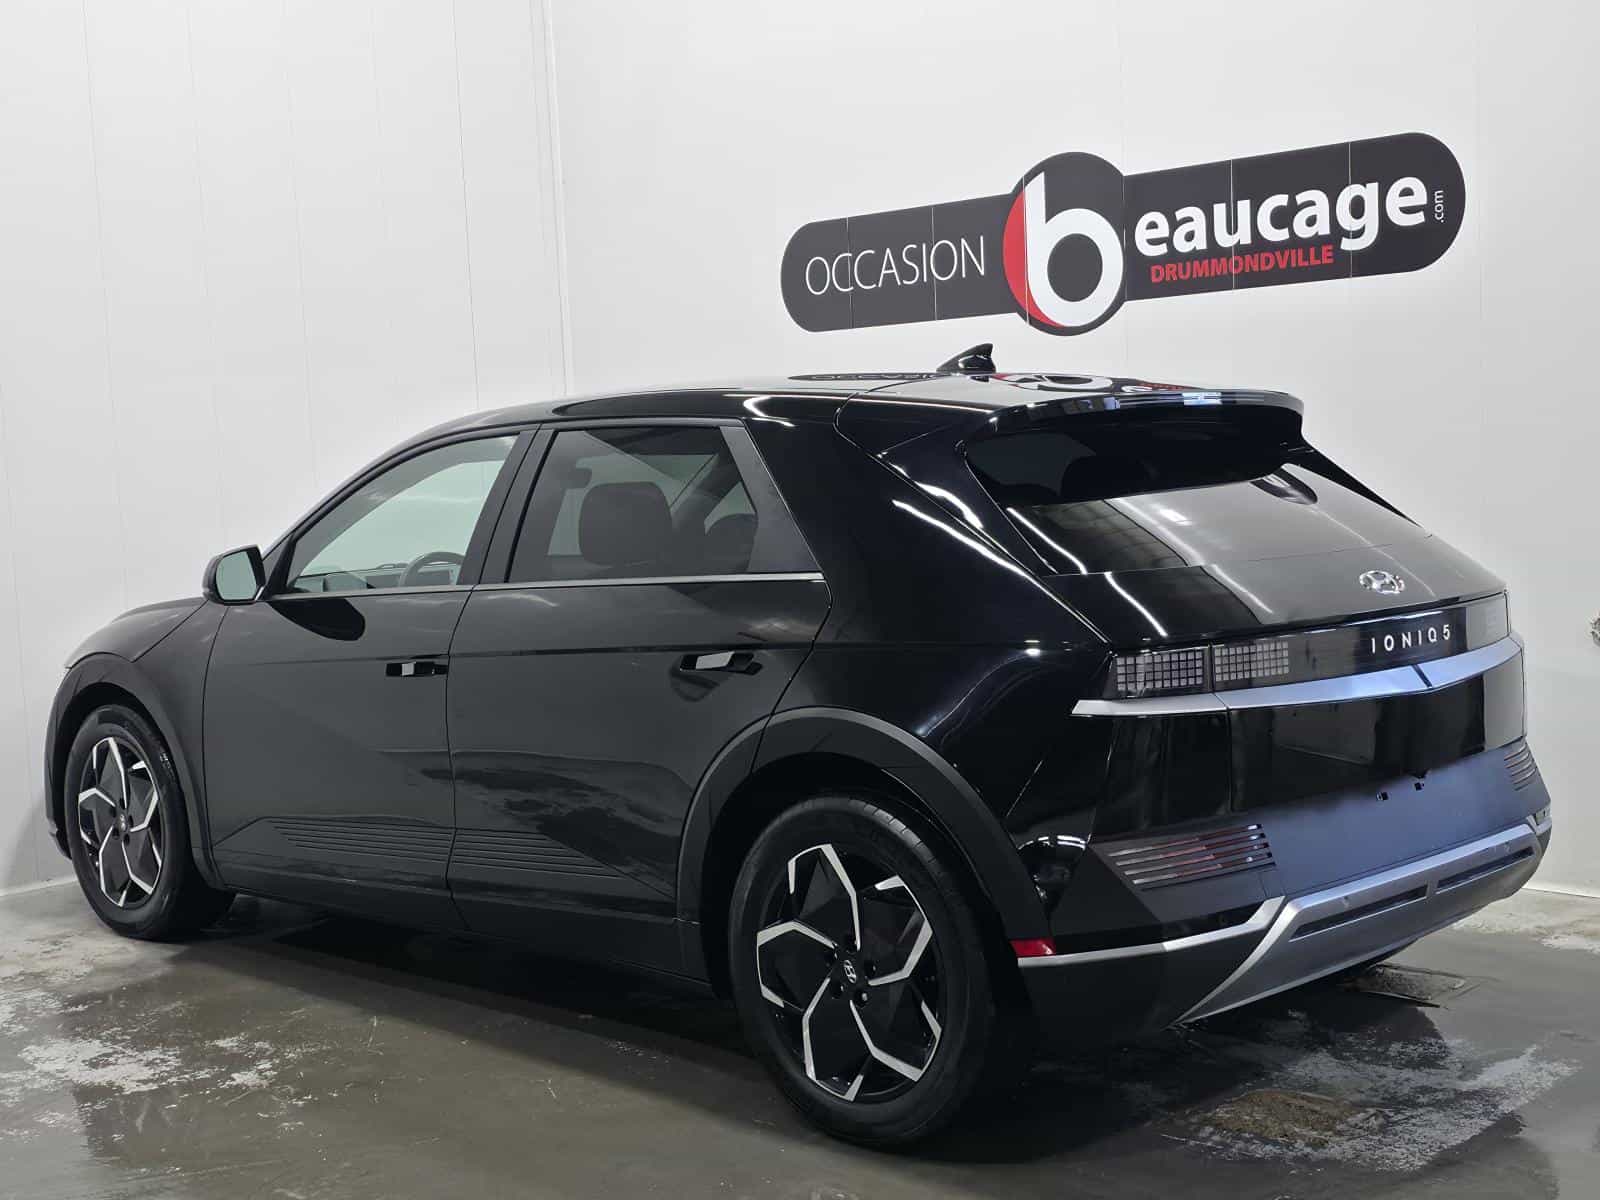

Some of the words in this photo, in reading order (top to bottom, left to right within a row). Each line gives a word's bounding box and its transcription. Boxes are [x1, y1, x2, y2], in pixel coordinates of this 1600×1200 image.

[804, 235, 986, 296] OCCASION
[1434, 189, 1446, 223] .com
[1150, 245, 1334, 283] DRUMMONDVILLE
